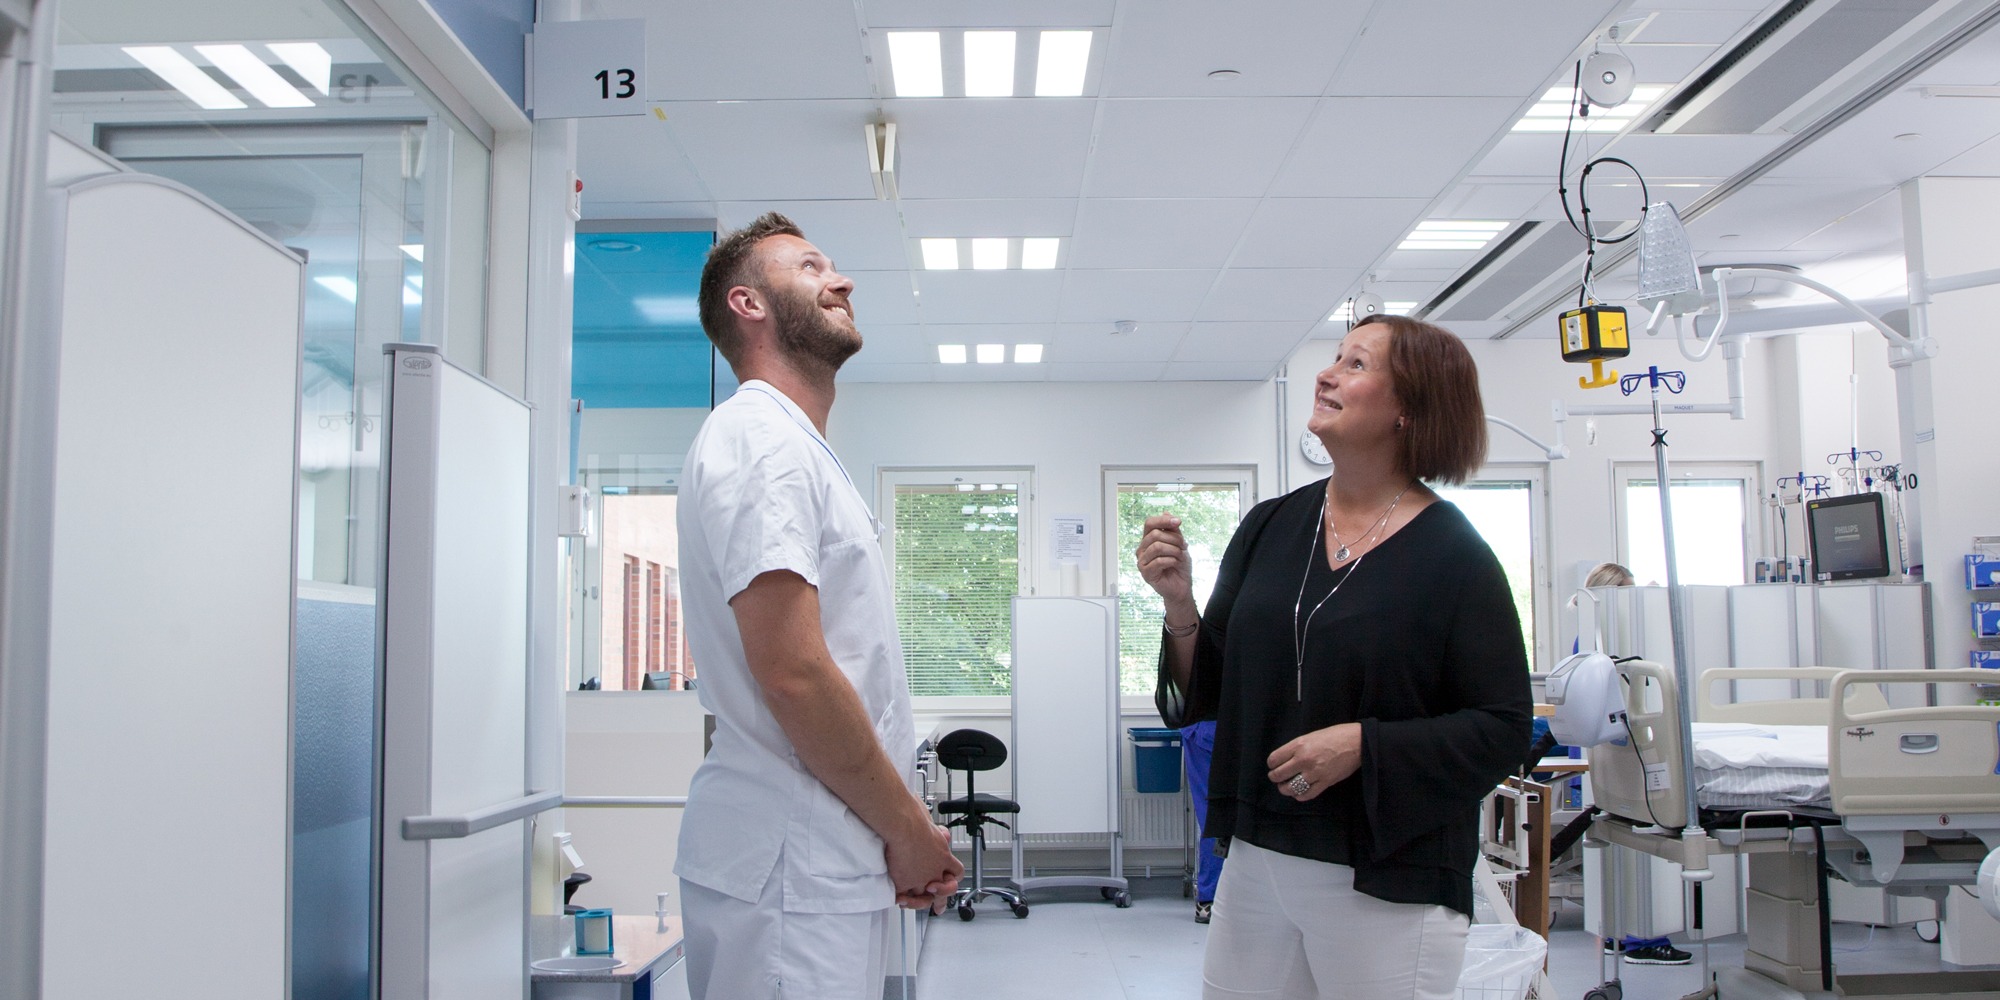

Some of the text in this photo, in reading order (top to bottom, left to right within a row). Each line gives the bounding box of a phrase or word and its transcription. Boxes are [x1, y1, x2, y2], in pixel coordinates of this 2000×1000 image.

[594, 68, 636, 99] 13
[1902, 473, 1918, 491] 10
[1834, 525, 1859, 535] PHILIPS
